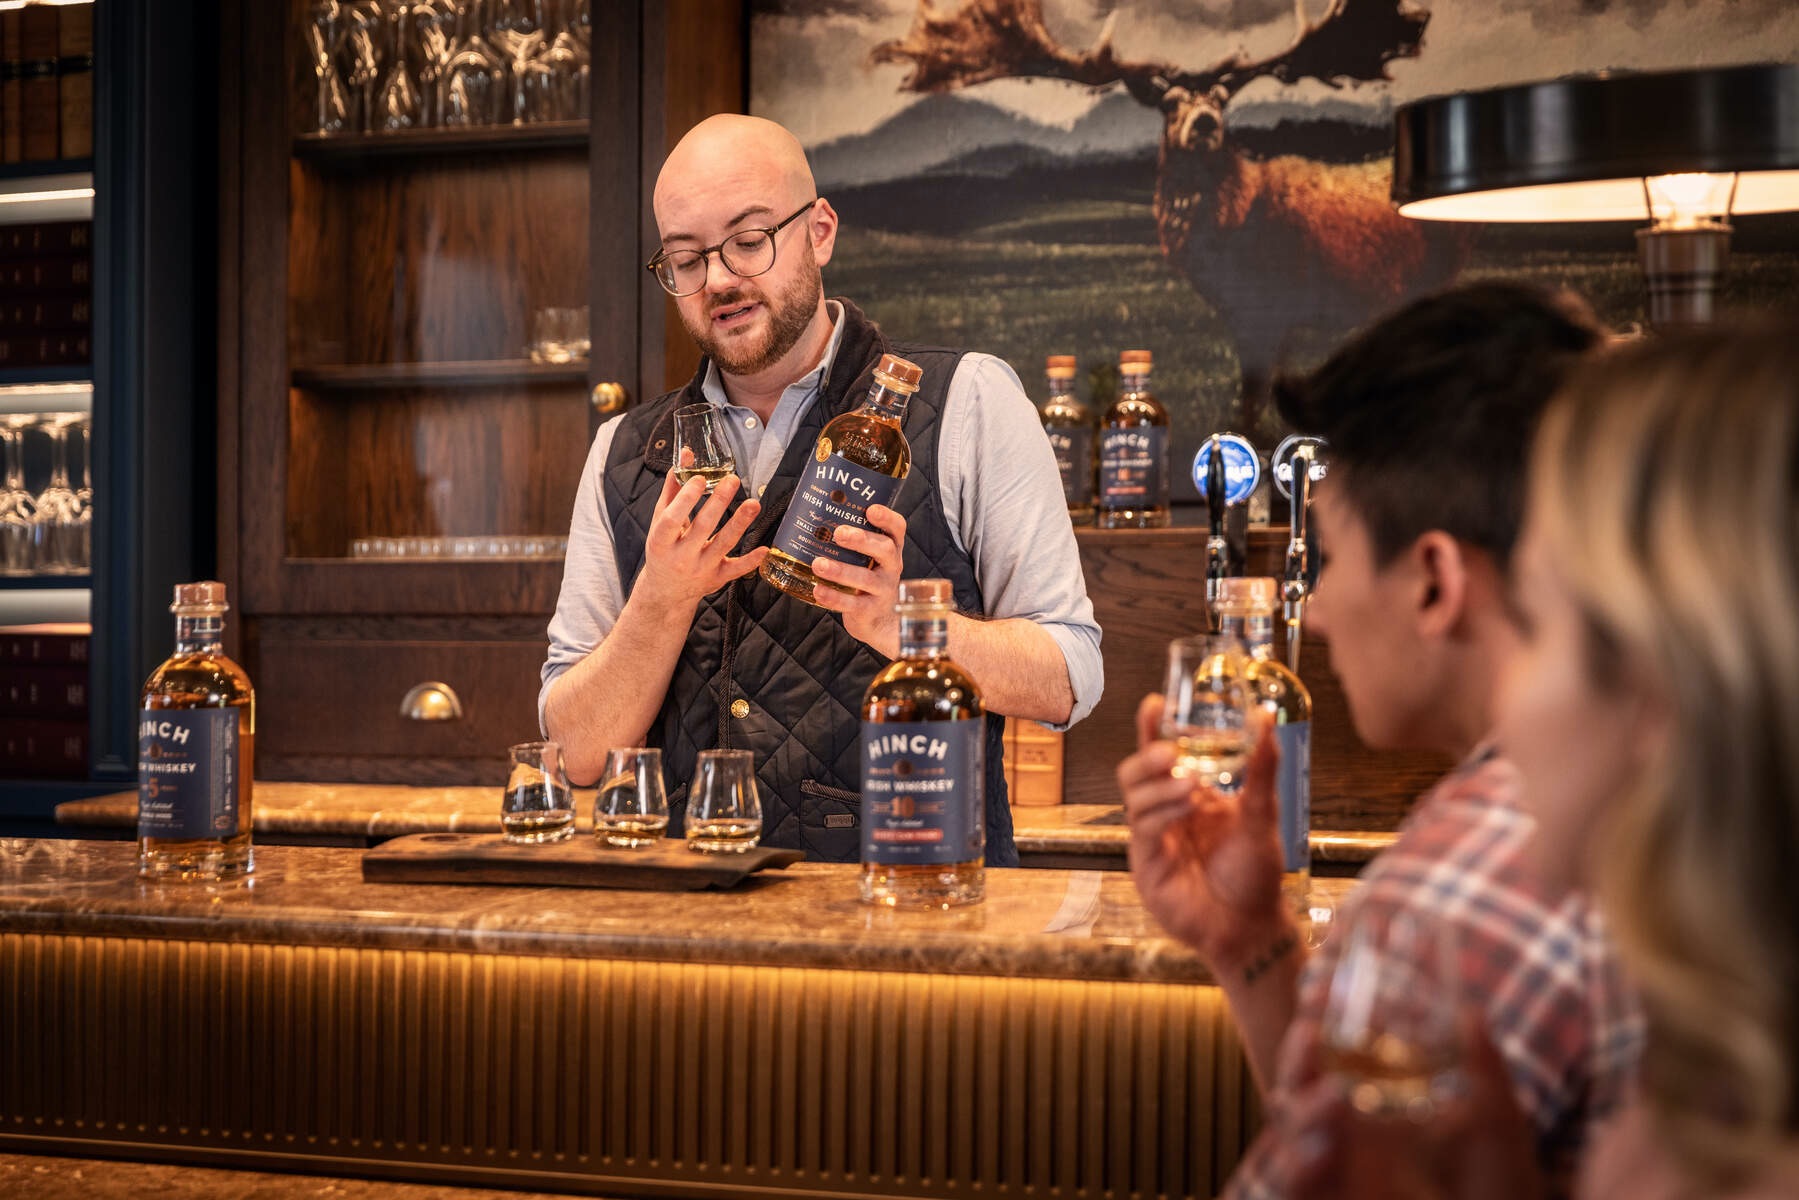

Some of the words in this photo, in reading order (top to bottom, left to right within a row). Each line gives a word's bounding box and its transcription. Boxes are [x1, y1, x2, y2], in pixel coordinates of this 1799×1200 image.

[815, 466, 876, 501] HINCH
[802, 491, 823, 508] IRISH
[825, 503, 868, 525] WHISKEY
[796, 519, 813, 533] SMALL
[867, 733, 949, 761] HINCH
[148, 762, 197, 774] WHISKEY
[148, 777, 159, 798] 5
[893, 778, 955, 793] WHISKEY
[890, 795, 915, 819] 10
